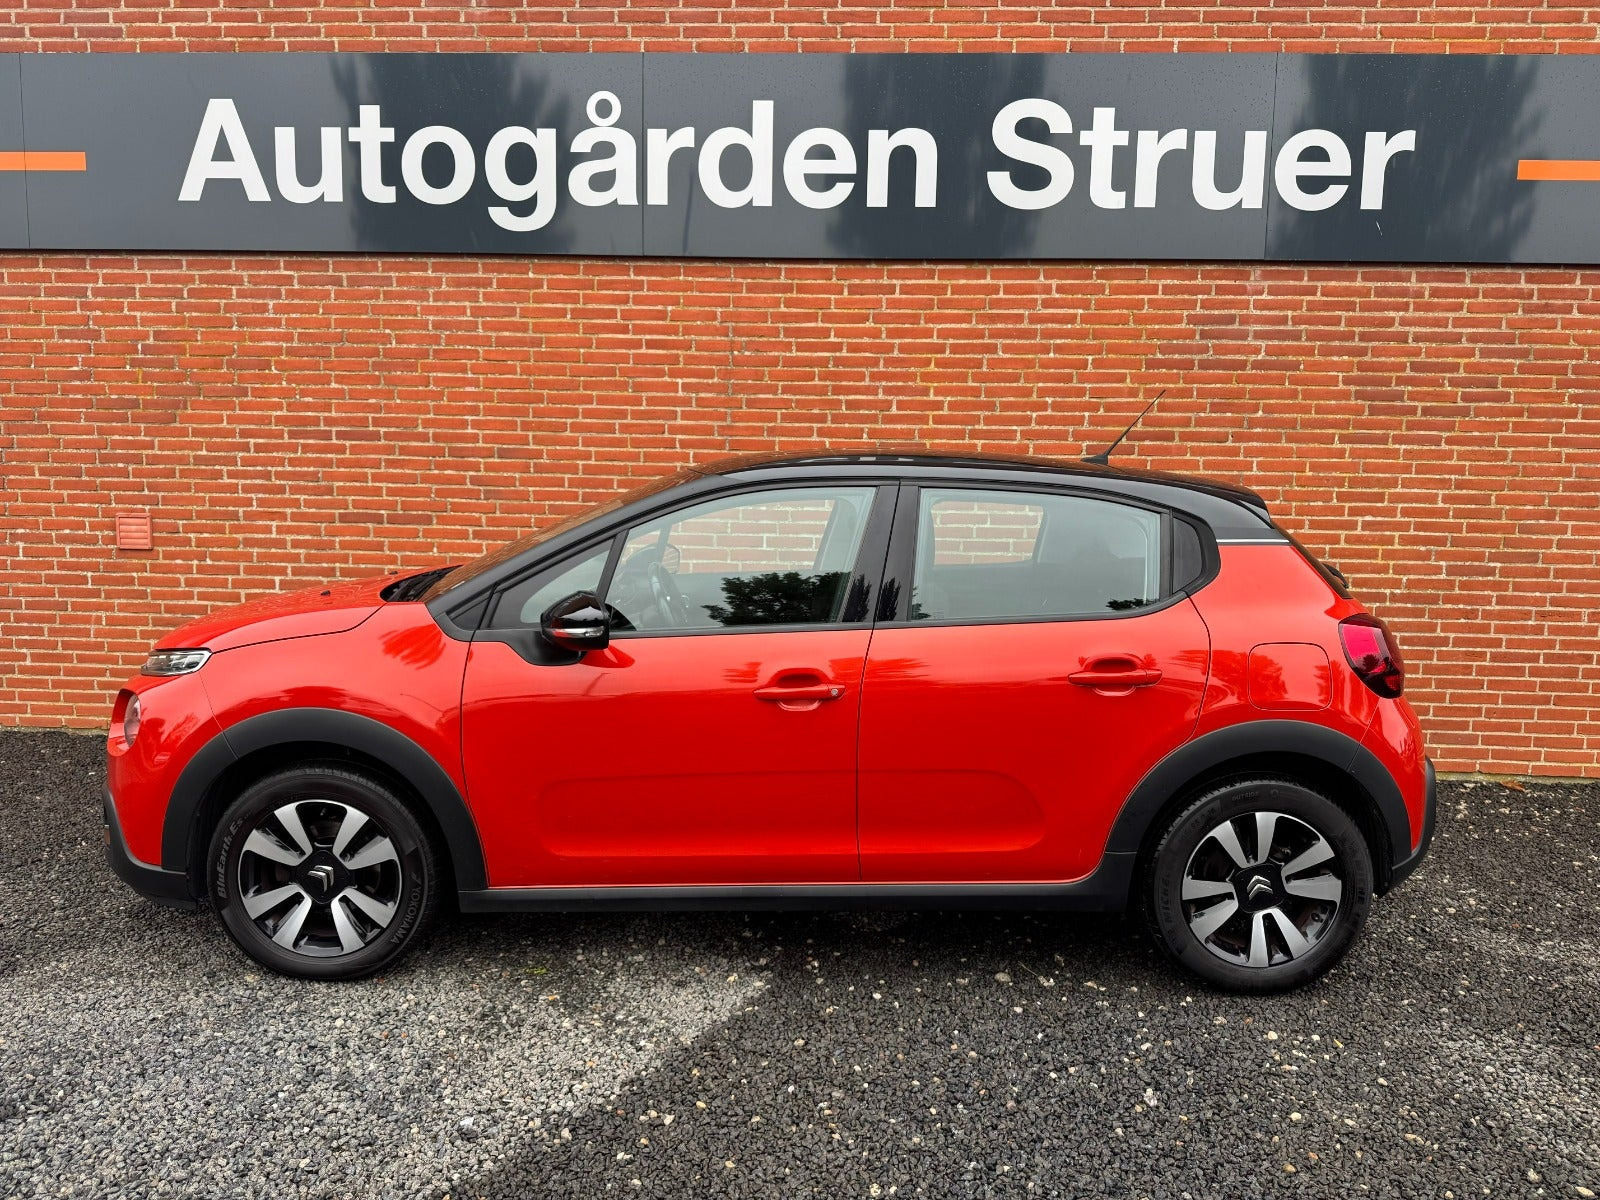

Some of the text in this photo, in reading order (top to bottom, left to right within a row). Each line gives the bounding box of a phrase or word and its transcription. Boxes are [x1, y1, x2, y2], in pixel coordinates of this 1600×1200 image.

[178, 91, 1417, 232] Autogården Struer
[391, 886, 422, 944] YOKOHAMA
